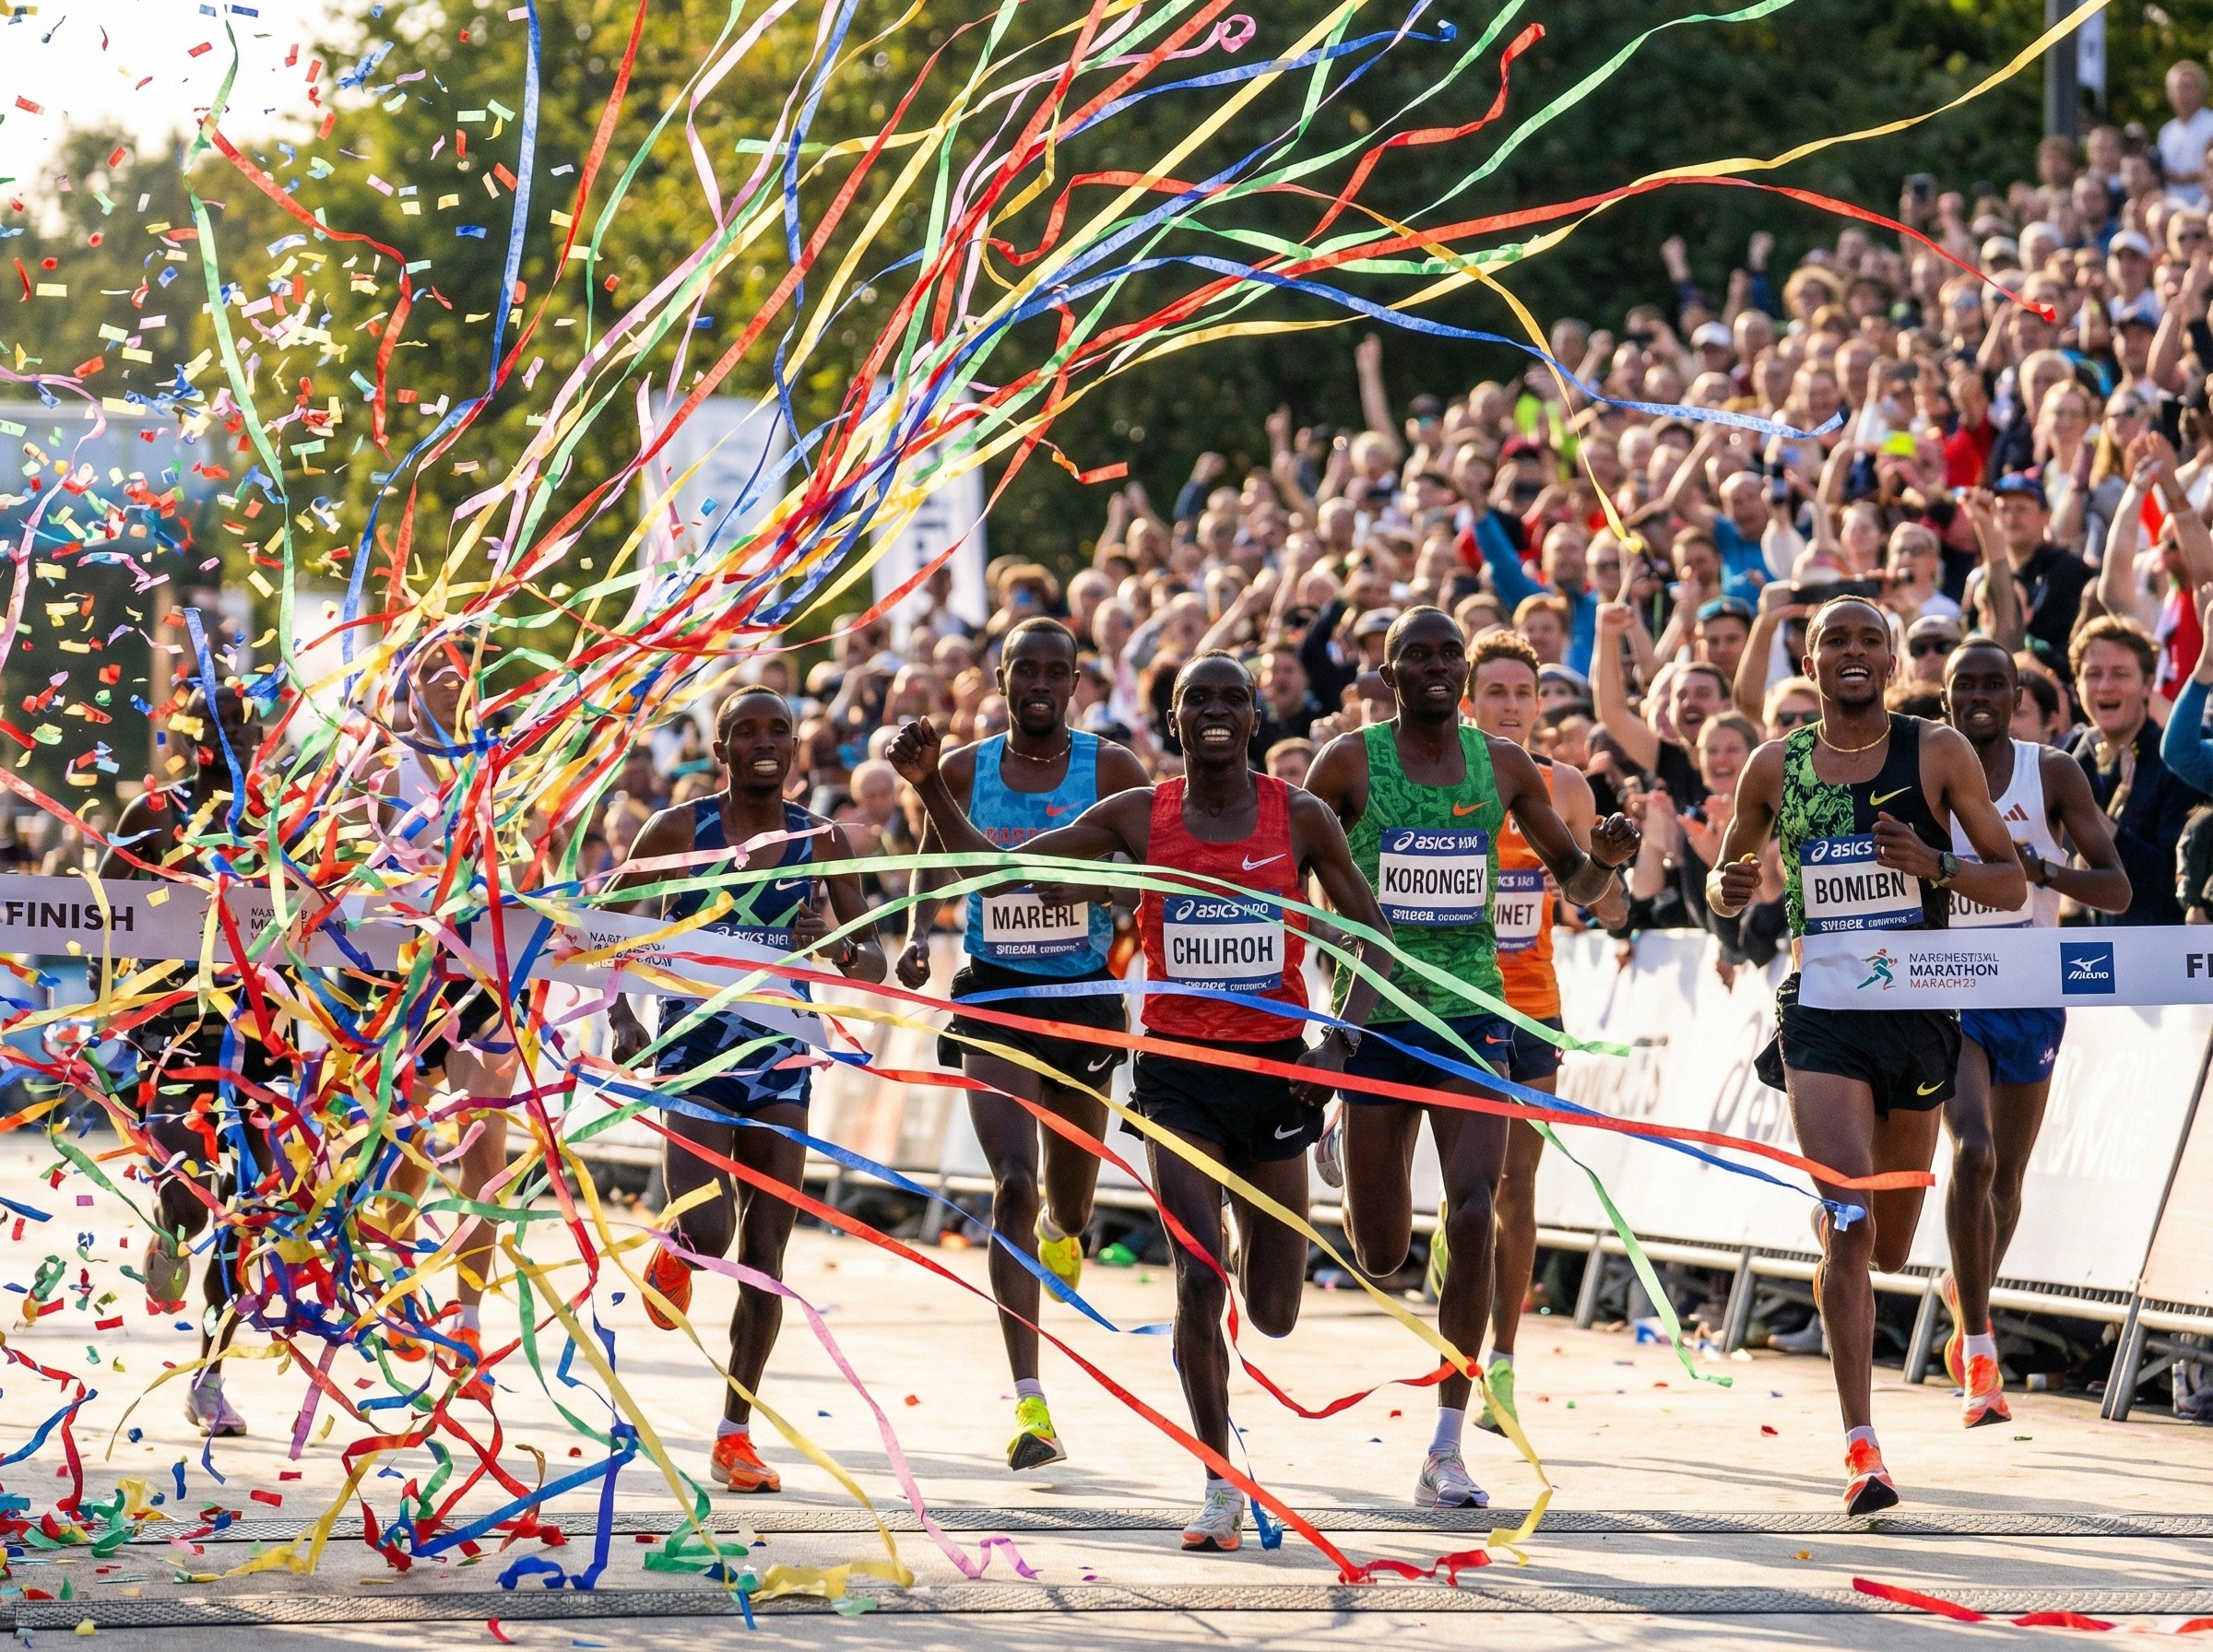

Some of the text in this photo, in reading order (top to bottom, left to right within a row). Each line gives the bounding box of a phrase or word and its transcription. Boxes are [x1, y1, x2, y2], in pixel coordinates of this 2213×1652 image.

[1415, 836, 1455, 850] asics
[1830, 841, 1873, 857] asics
[1386, 867, 1484, 894] KORONGEY
[6, 902, 134, 932] FINISH
[1196, 904, 1239, 918] asics
[1910, 964, 1998, 976] MARATHON
